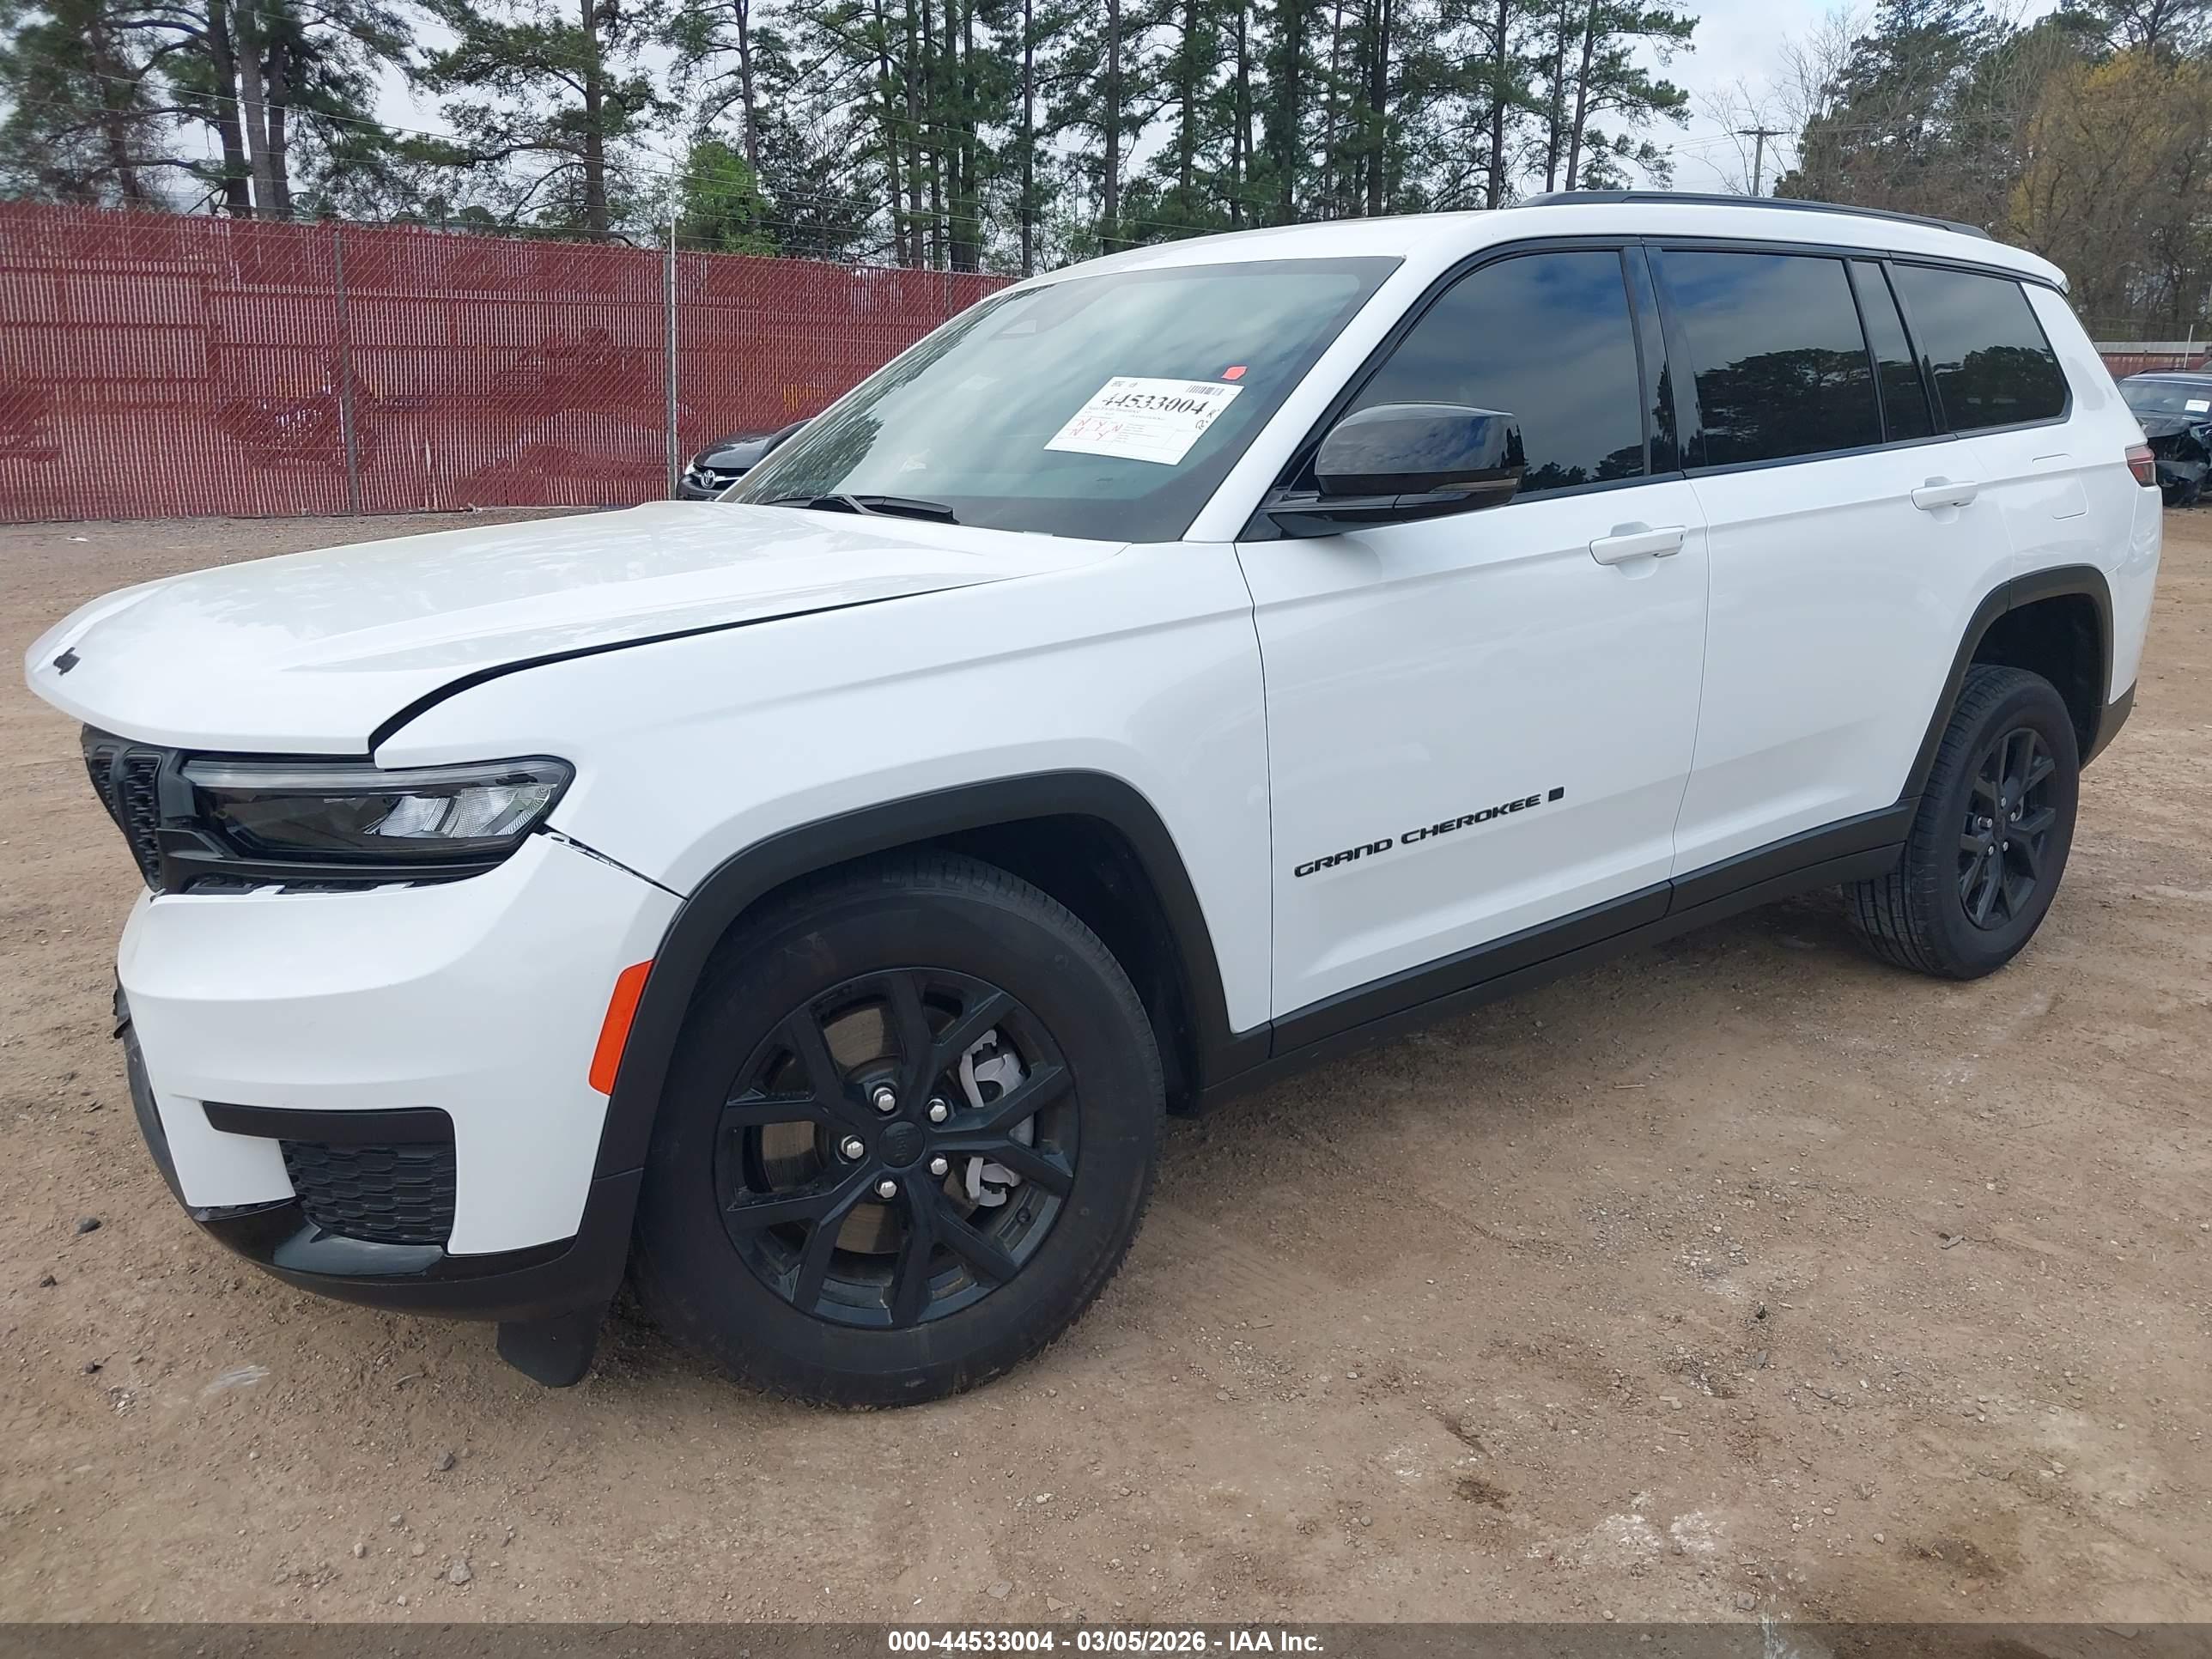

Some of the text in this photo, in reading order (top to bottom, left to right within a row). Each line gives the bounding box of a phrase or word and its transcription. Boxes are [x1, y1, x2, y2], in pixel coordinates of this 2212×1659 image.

[1103, 392, 1209, 415] 44533004
[1294, 793, 1542, 878] GRAND CHEROKEE
